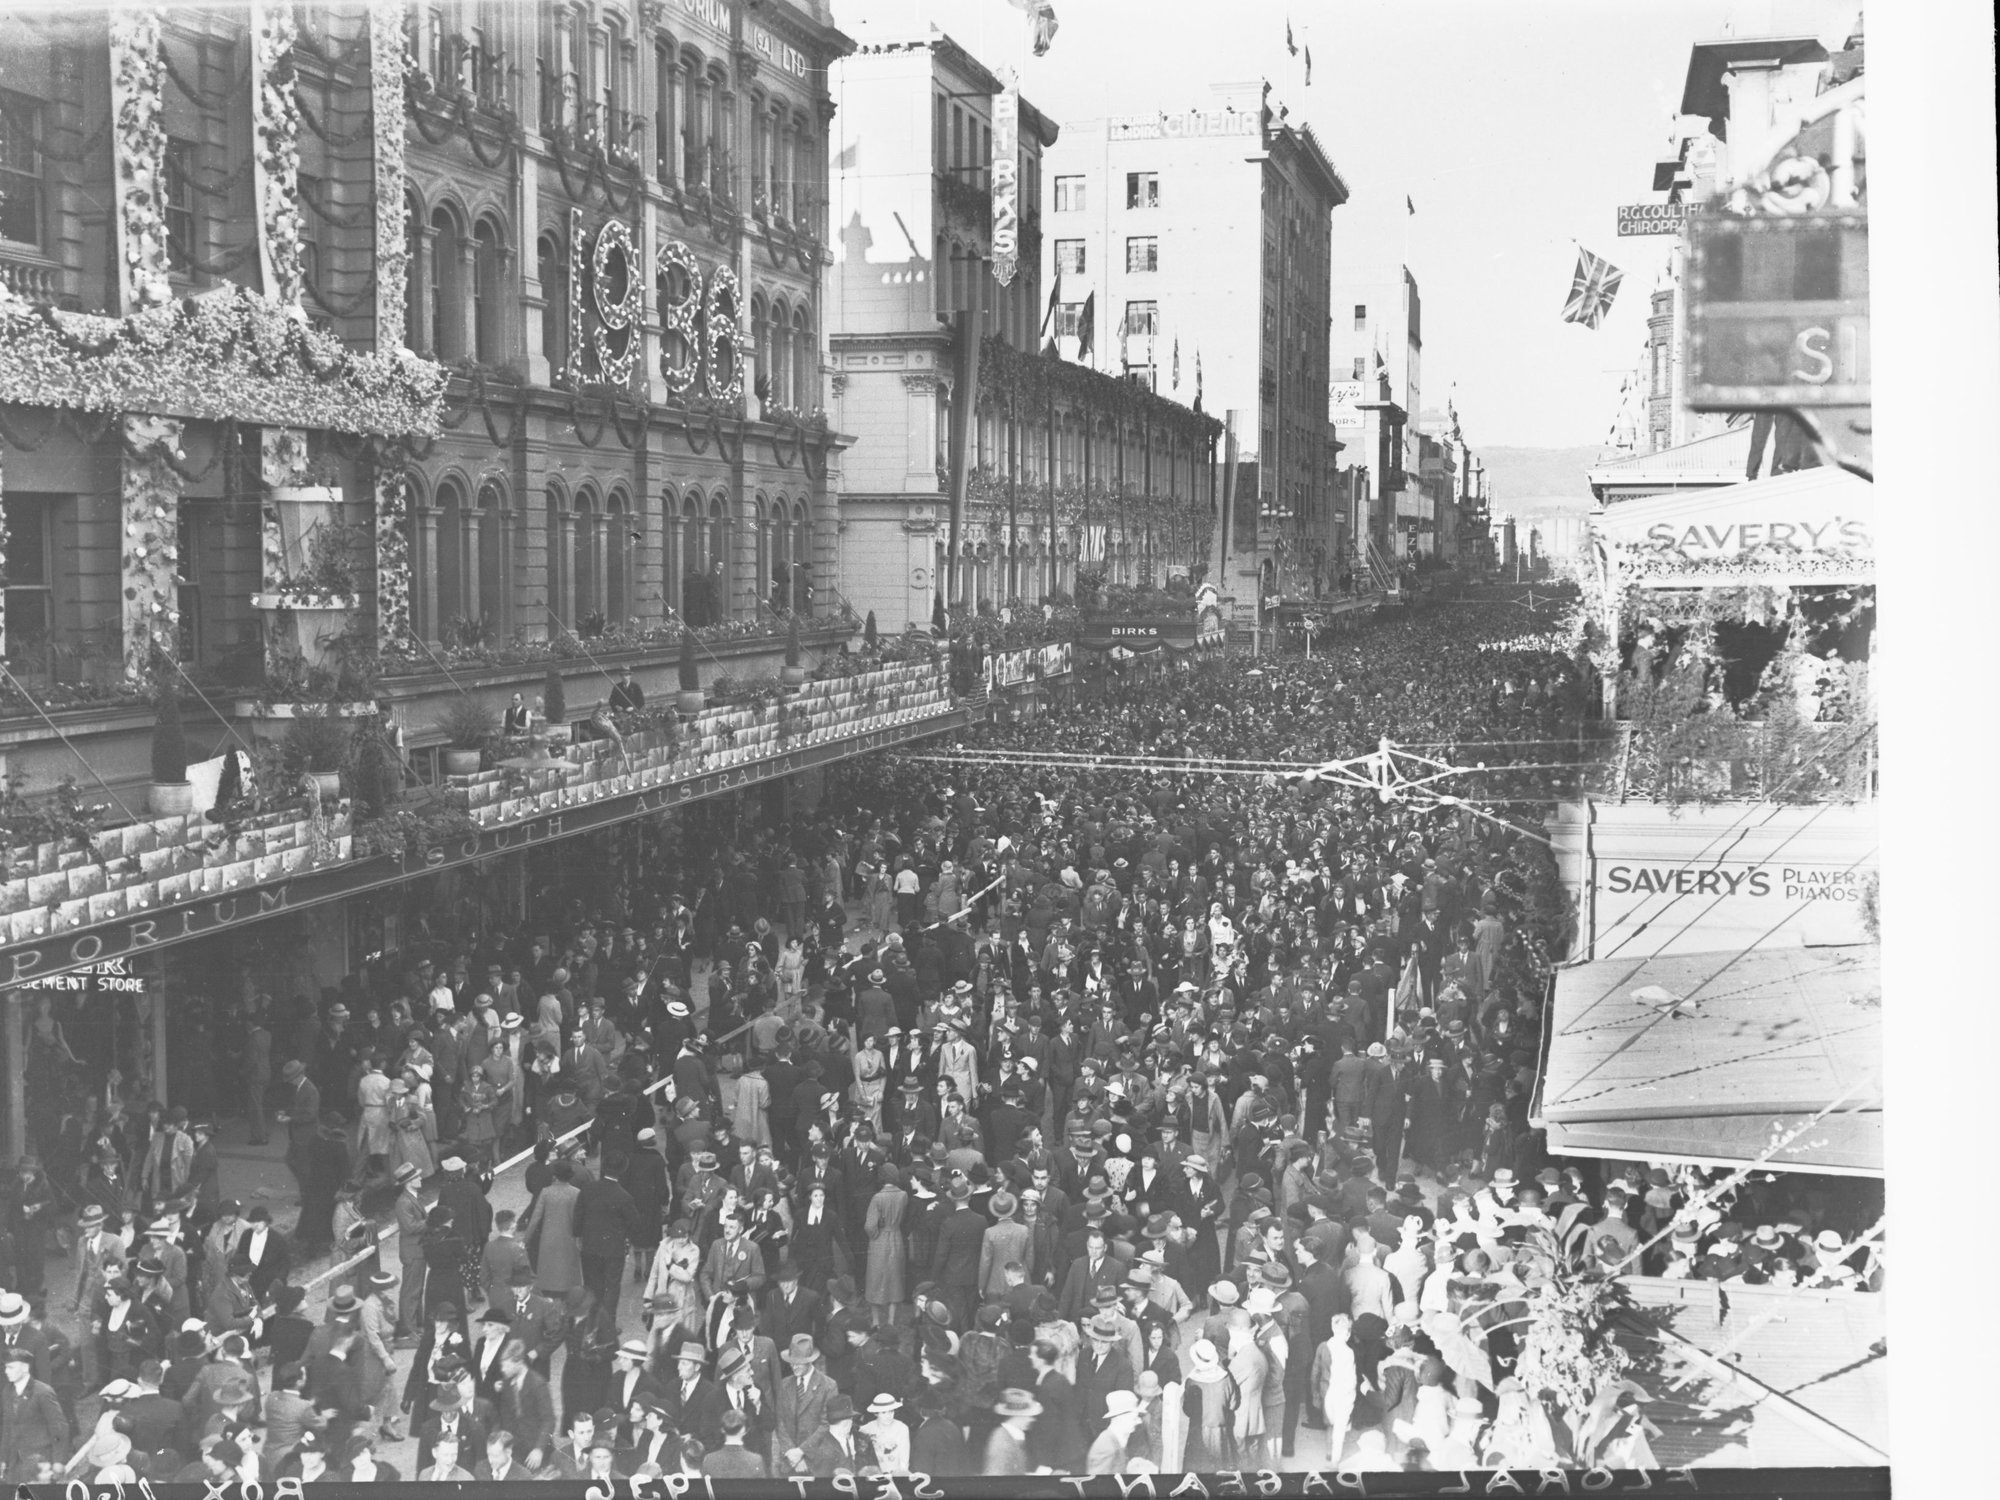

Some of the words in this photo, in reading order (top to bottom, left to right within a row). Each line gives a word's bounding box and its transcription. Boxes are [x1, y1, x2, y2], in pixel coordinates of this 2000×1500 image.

[1163, 111, 1259, 138] CINEMA
[993, 93, 1016, 255] BIRKS
[567, 206, 747, 400] 1936
[1407, 524, 1417, 571] EZYS
[1647, 516, 1870, 550] SAVERY'S
[1111, 627, 1158, 636] BIRKS
[9, 883, 291, 983] PORIUM
[425, 816, 562, 868] SOUTH
[633, 757, 794, 813] AUSTRALIA
[843, 725, 919, 756] LIMITED
[1607, 866, 1771, 897] SAVERY'S
[1782, 867, 1857, 885] PLAYER
[1785, 884, 1859, 902] PIANOS
[97, 976, 145, 993] STORE
